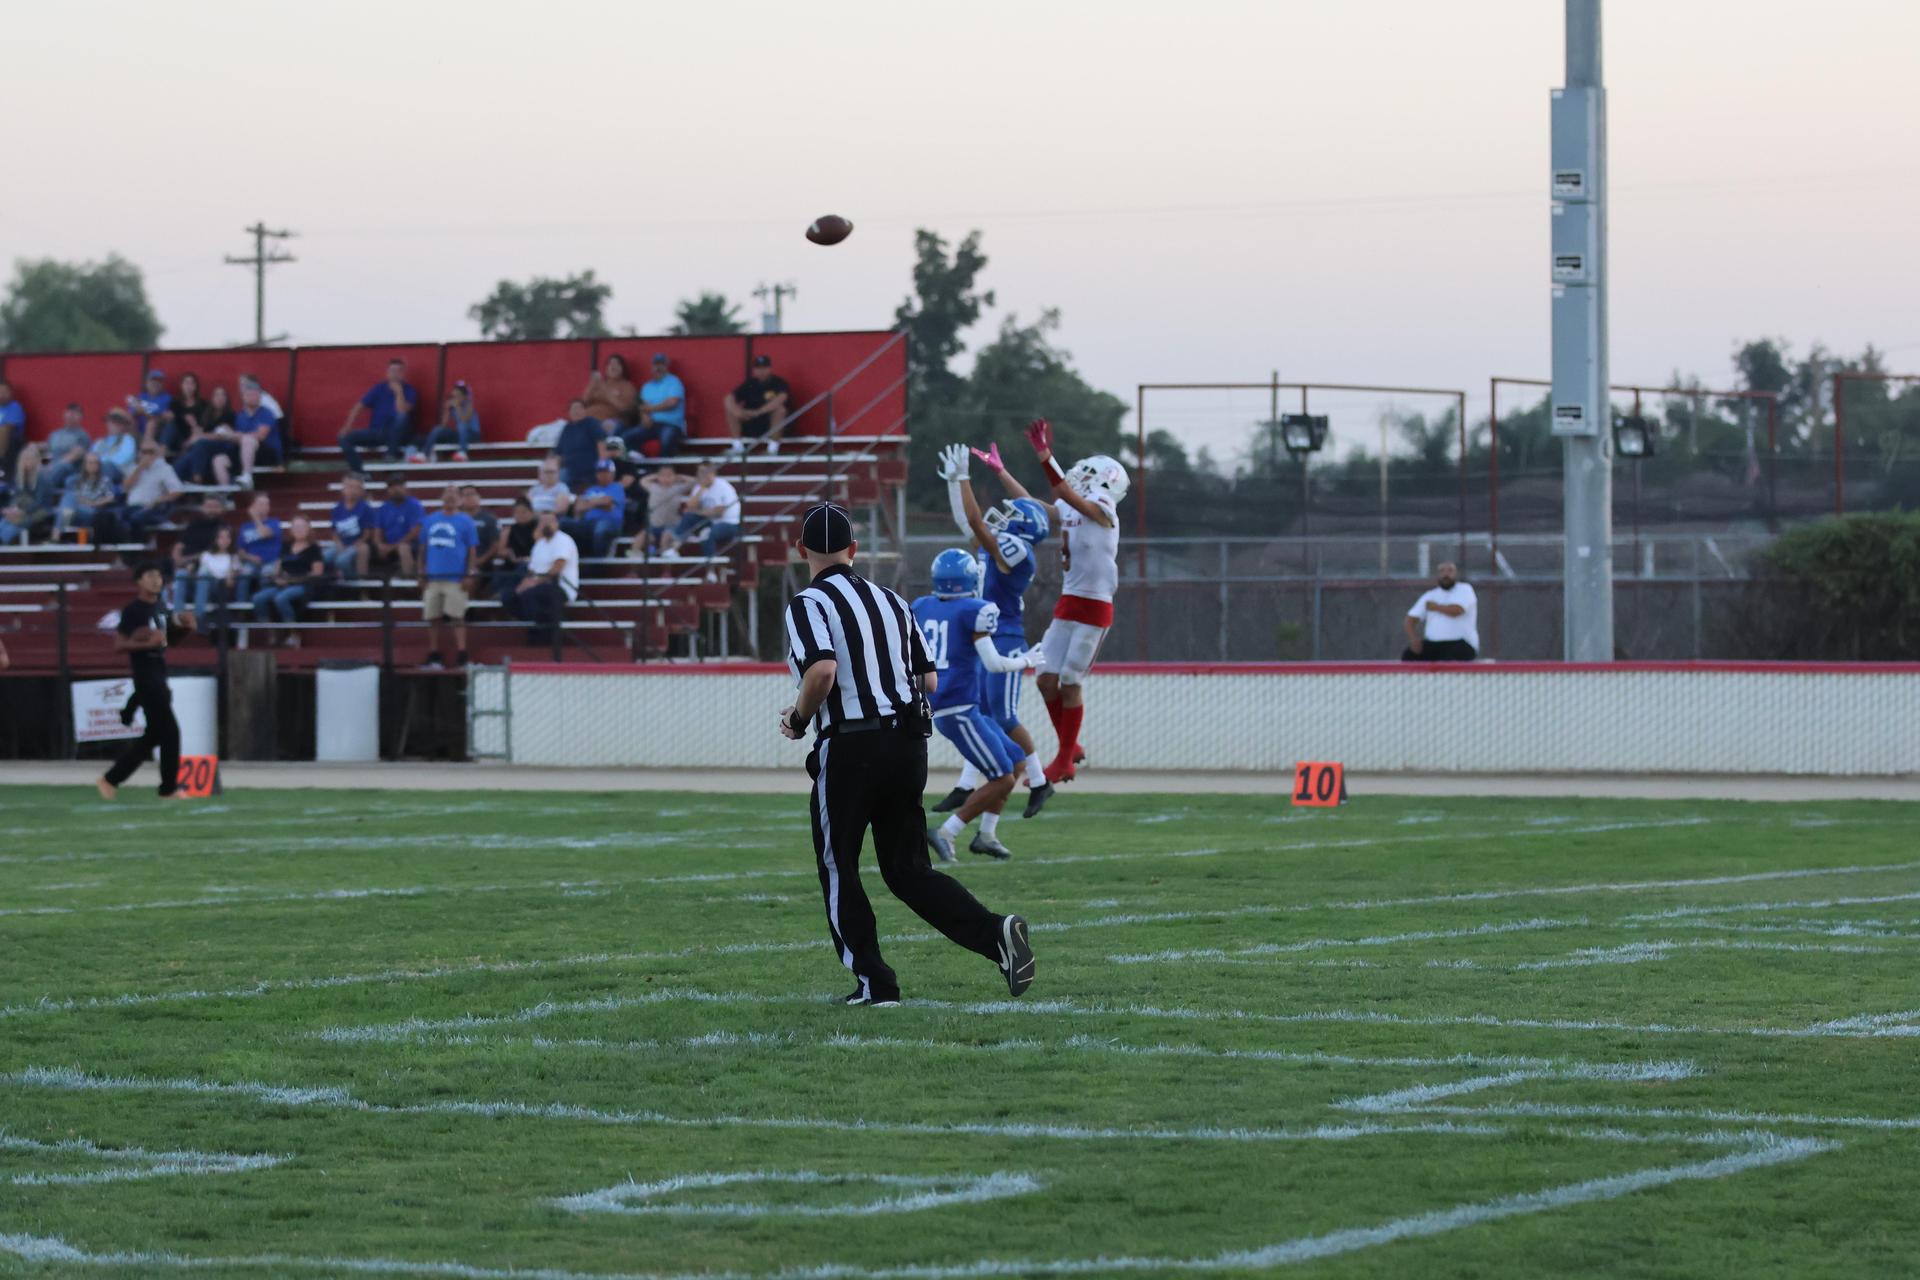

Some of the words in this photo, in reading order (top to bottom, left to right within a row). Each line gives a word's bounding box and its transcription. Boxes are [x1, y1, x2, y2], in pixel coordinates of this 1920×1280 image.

[924, 619, 949, 670] 31
[179, 758, 210, 791] 20
[1296, 765, 1335, 801] 10
